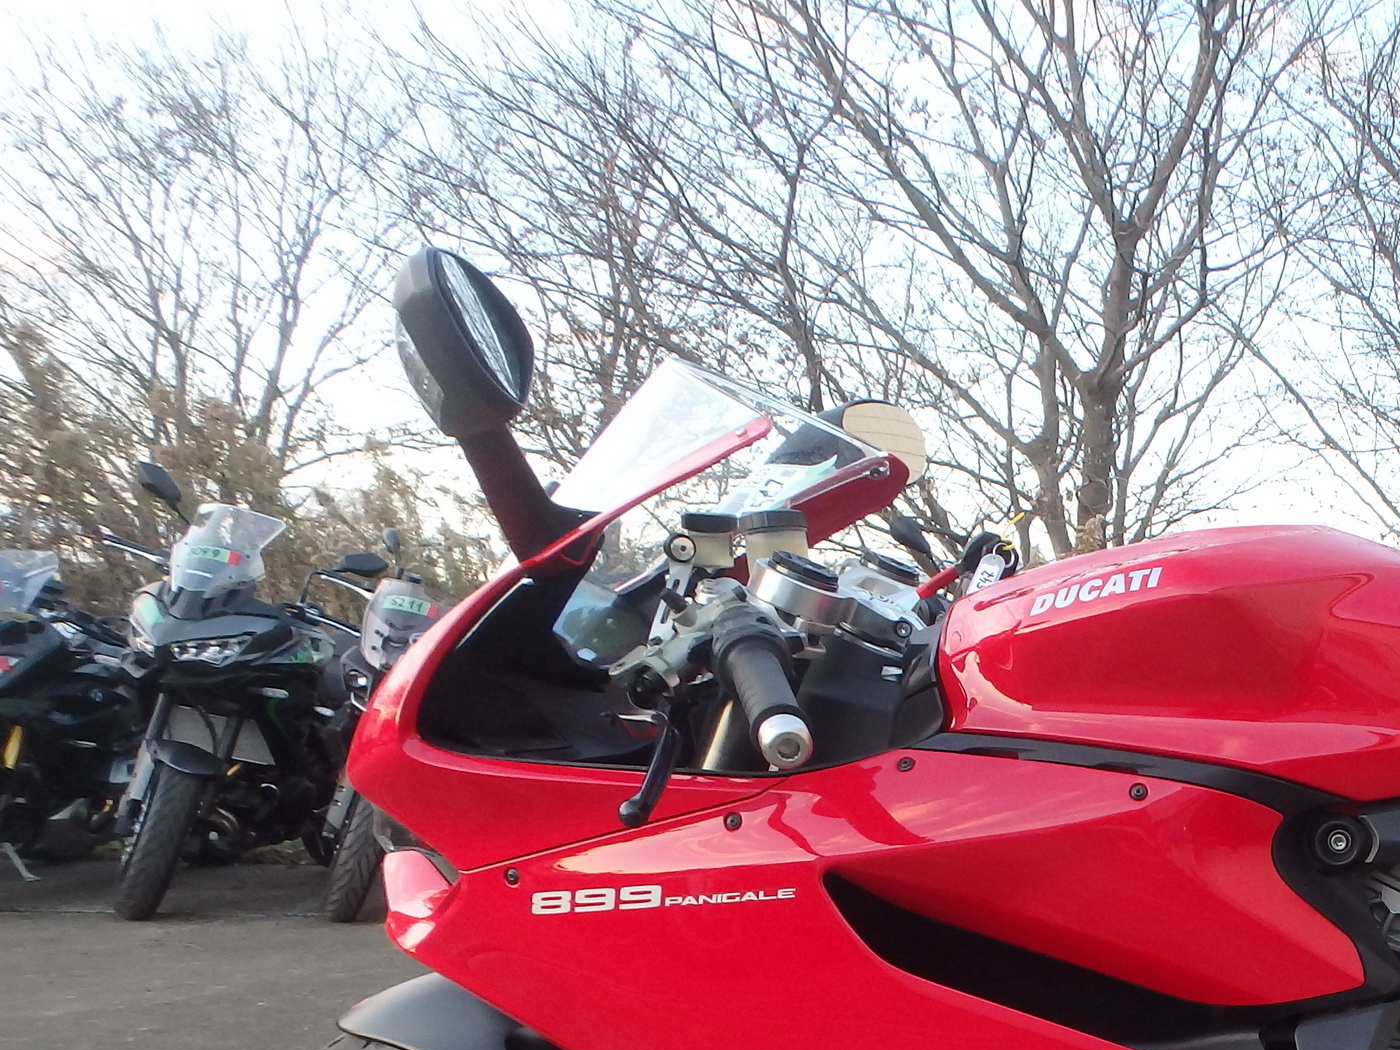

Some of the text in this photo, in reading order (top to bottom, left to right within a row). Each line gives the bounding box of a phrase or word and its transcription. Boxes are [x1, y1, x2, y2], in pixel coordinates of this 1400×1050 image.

[1029, 567, 1163, 617] DUCATI
[531, 885, 797, 915] 899 PANIGALE
